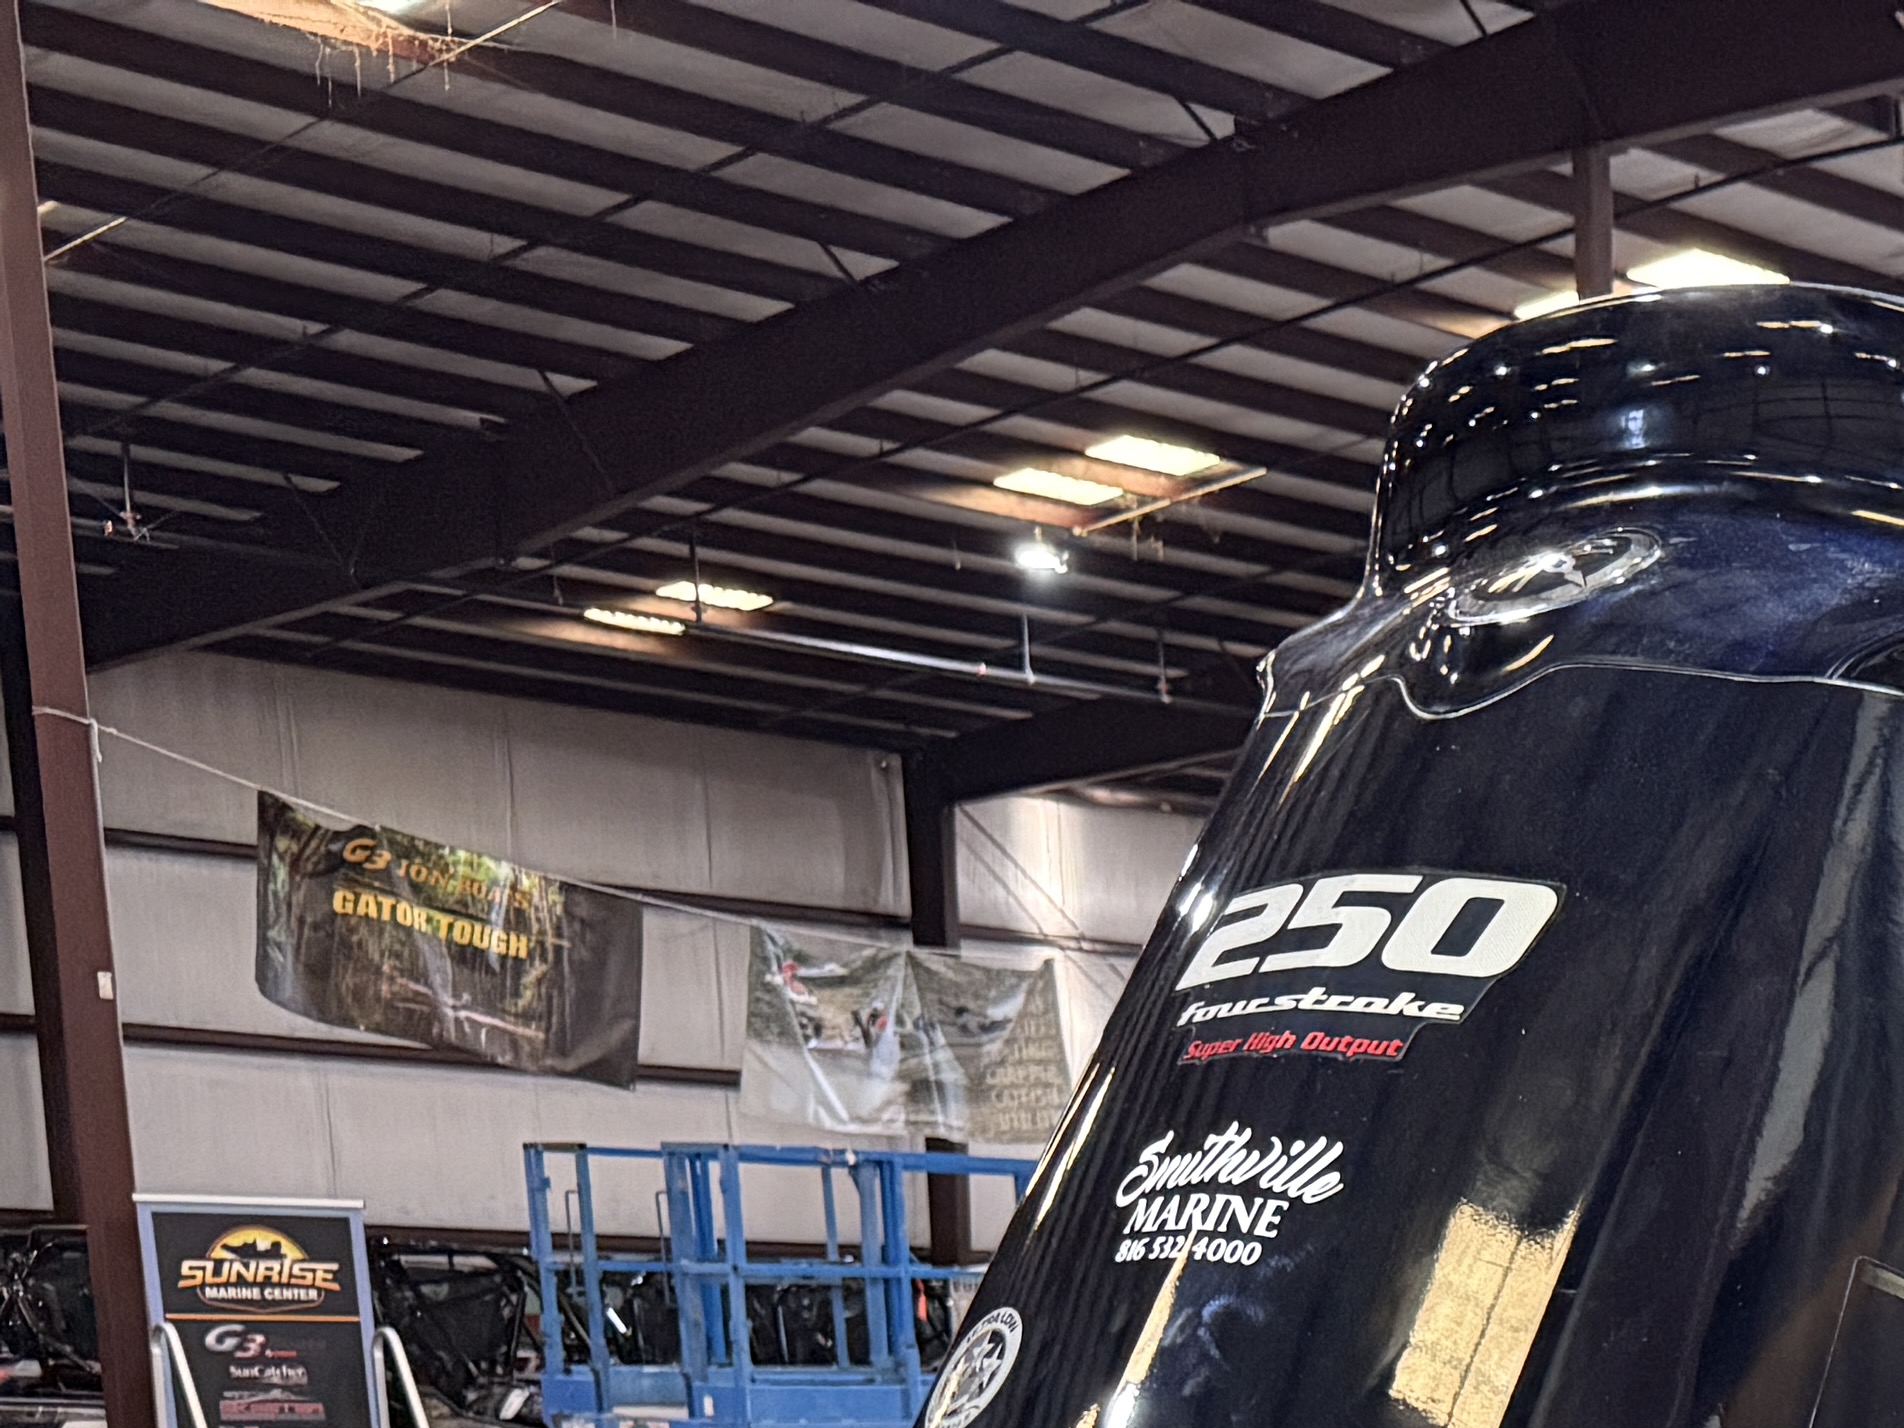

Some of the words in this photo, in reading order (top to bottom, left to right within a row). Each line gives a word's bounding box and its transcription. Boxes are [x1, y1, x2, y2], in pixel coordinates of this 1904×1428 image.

[342, 838, 393, 870] G3
[332, 889, 429, 934] GATOR
[438, 914, 529, 960] TOUGH
[1175, 873, 1558, 992] 250
[1182, 1034, 1239, 1060] Super
[1243, 1031, 1296, 1053] High
[1300, 1031, 1403, 1058] Output
[1115, 1121, 1345, 1208] Smithville
[1122, 1192, 1290, 1240] MARINE
[1115, 1237, 1145, 1263] 816
[1148, 1236, 1187, 1260] 532
[1192, 1238, 1263, 1265] 4000
[177, 1258, 342, 1291] SUNRISE
[205, 1286, 262, 1300] MARINE
[264, 1287, 319, 1301] CENTER
[204, 1322, 267, 1358] G3
